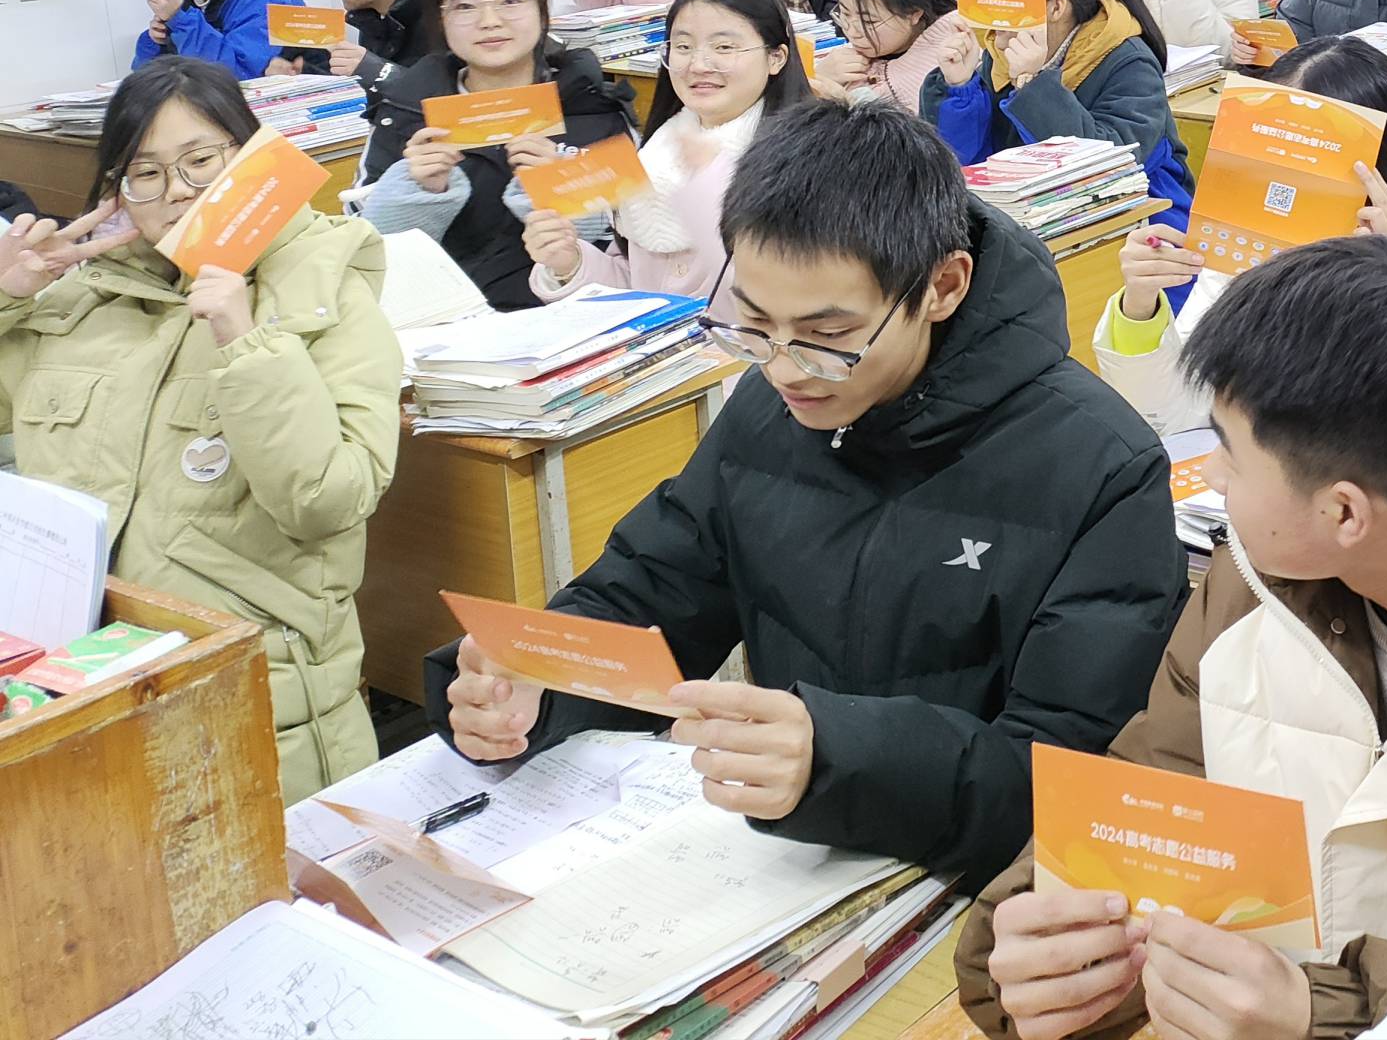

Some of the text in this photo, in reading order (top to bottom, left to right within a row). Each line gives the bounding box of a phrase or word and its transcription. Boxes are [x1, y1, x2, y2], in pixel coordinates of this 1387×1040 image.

[1250, 121, 1342, 154] 2024高考志愿公益服务
[1090, 820, 1238, 872] 2024高考志愿公益服务
